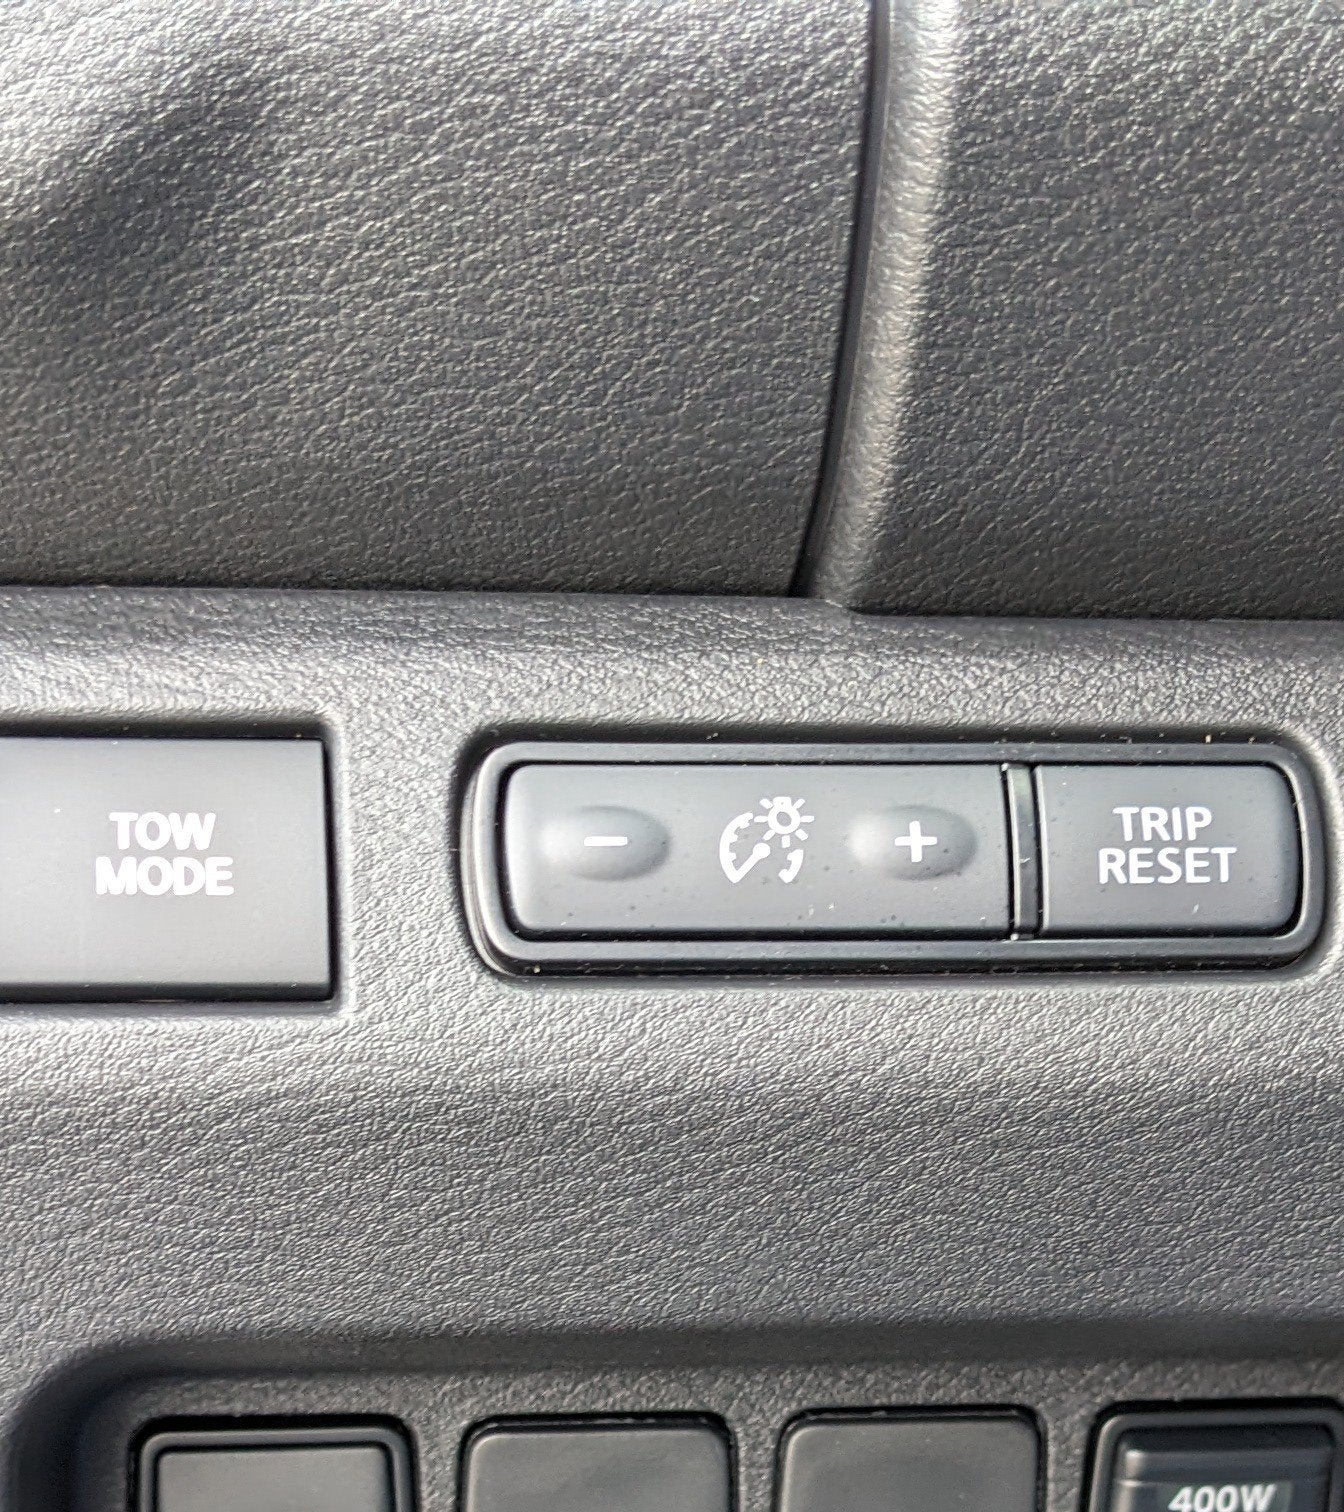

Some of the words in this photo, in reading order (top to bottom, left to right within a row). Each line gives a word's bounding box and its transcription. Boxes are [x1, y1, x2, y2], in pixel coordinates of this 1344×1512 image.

[109, 811, 216, 851] TOW
[1112, 806, 1212, 842] TRIP
[94, 856, 235, 897] MODE
[1098, 846, 1238, 885] RESET
